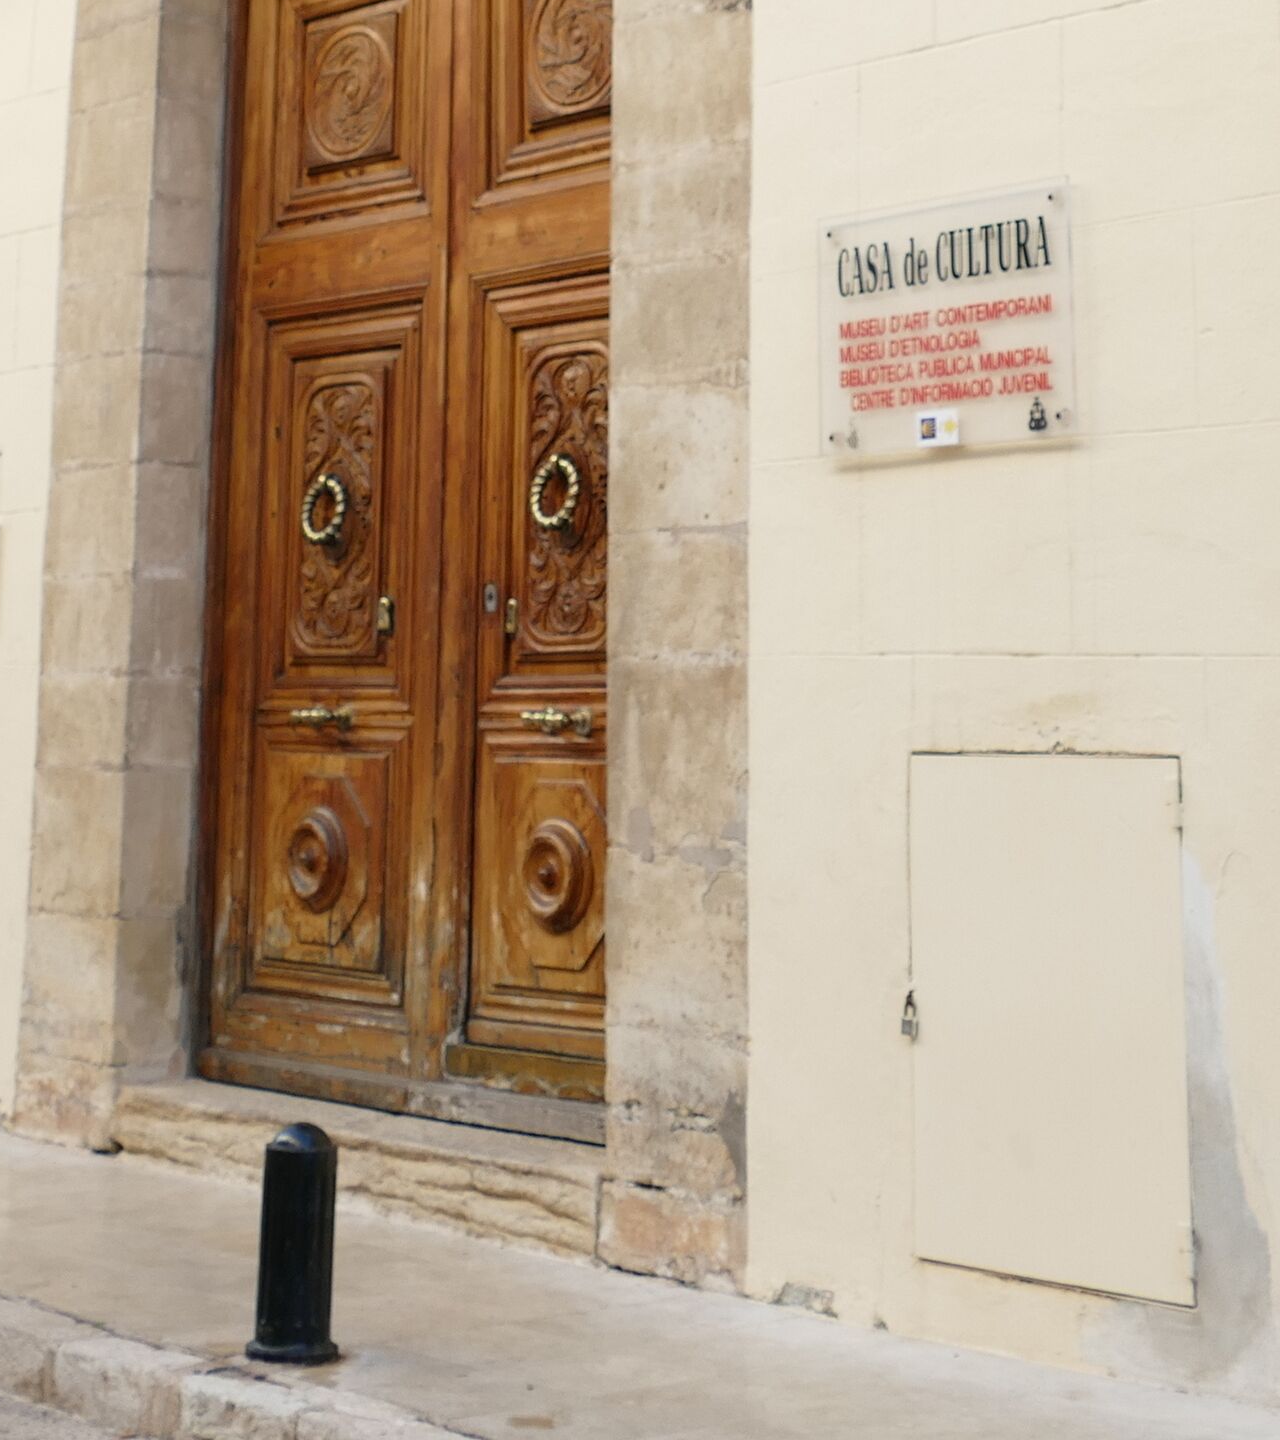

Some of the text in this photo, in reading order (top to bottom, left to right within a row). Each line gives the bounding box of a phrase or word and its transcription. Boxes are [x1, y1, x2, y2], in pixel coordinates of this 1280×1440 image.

[837, 215, 1052, 297] CASA de CULTURA
[839, 294, 1053, 340] MUSEU D'ART CONTEMPORANI
[839, 329, 981, 364] MUSEU D'ETNOLOGIA
[839, 363, 915, 389] BIBLIOTECA
[980, 346, 1053, 372] MUNICIPAL
[851, 389, 895, 412] CENTRE
[998, 371, 1053, 396] JUVENIL
